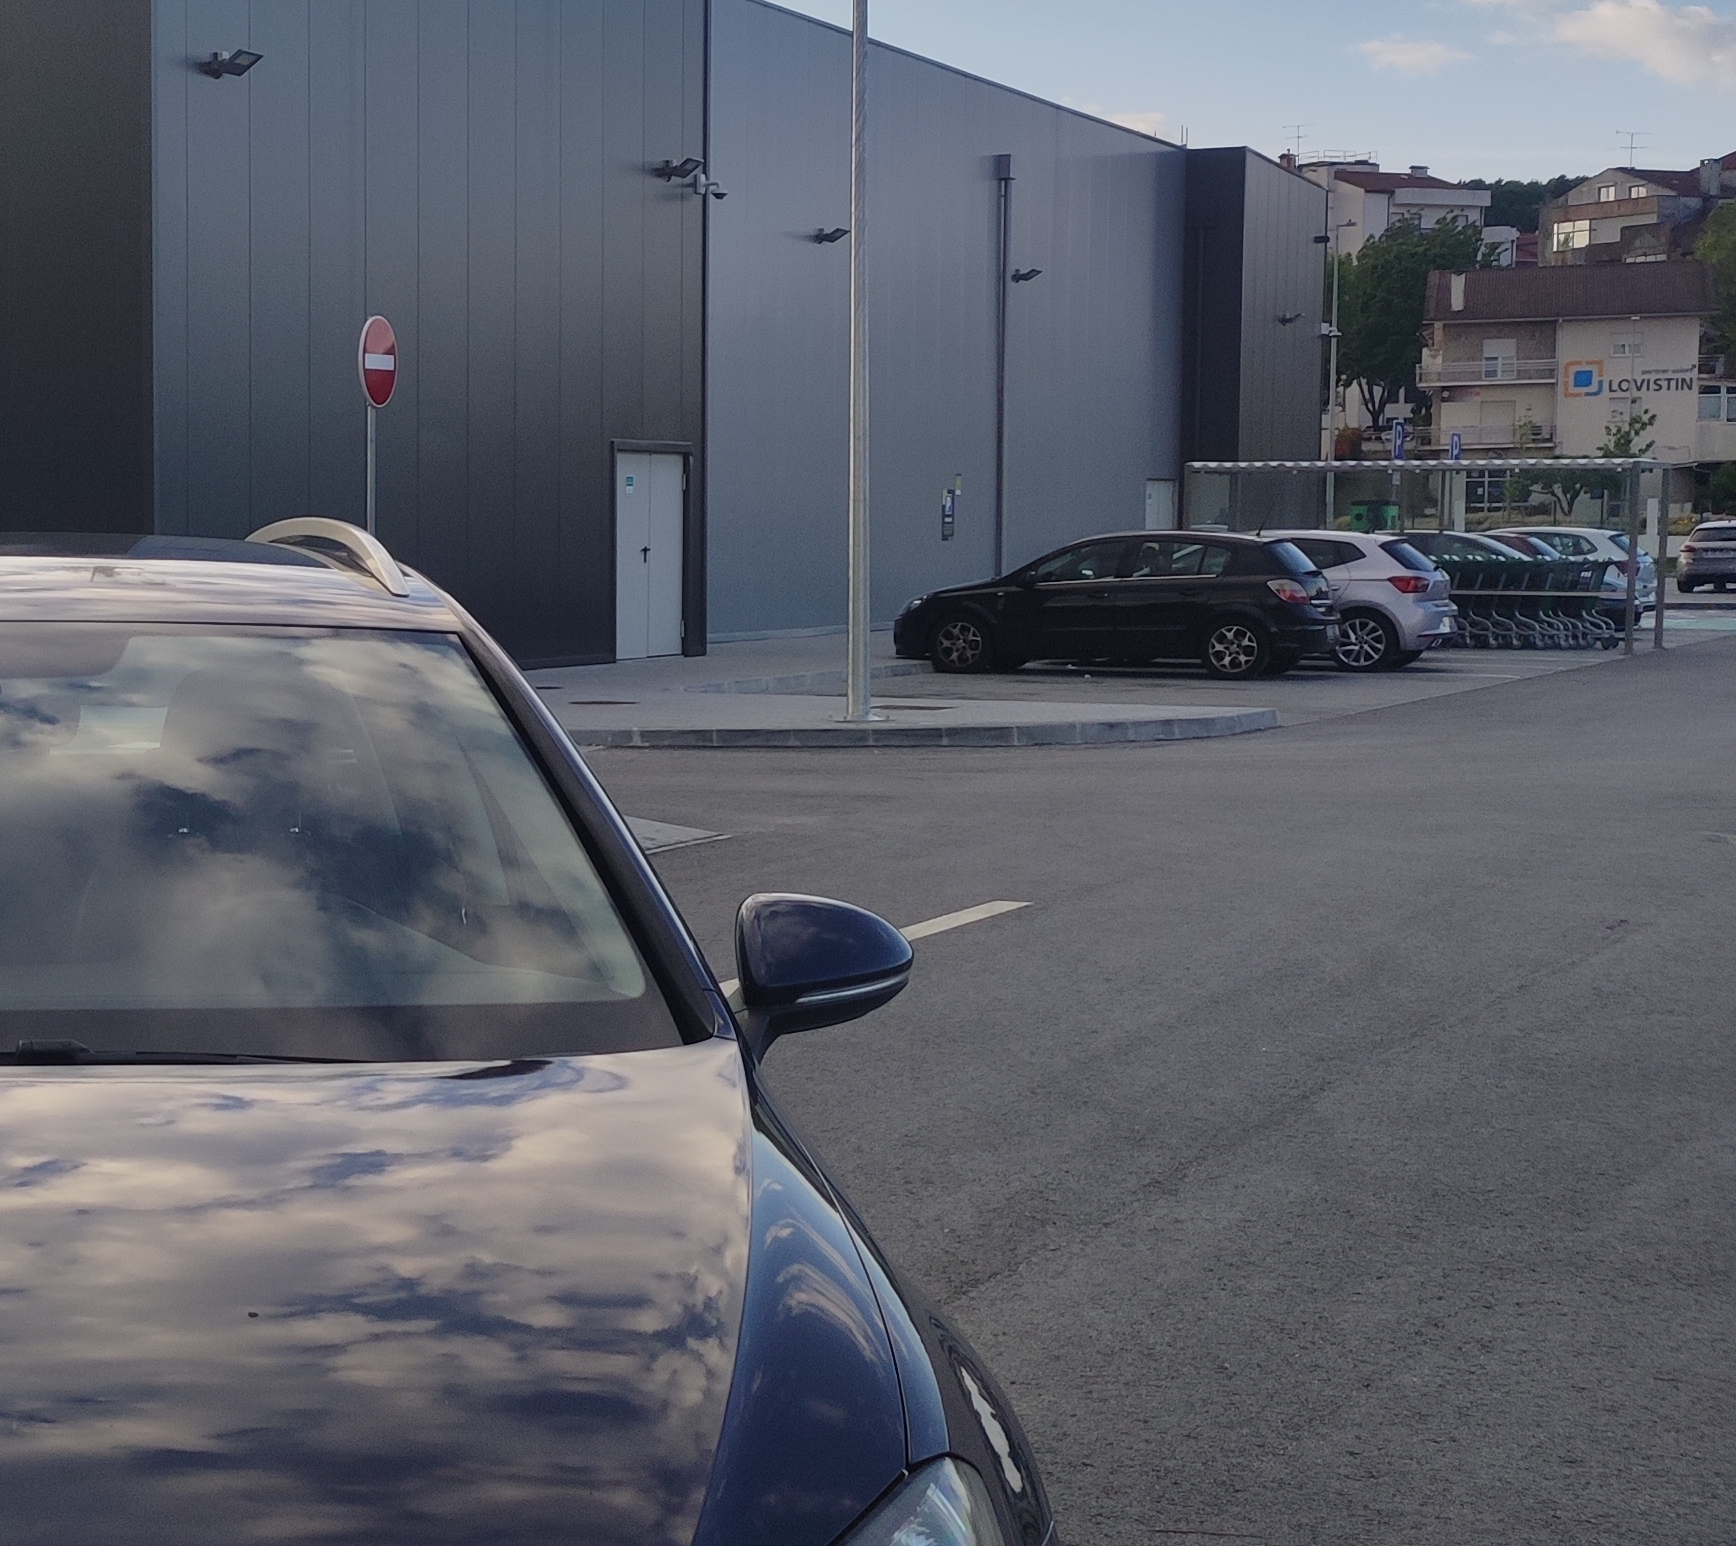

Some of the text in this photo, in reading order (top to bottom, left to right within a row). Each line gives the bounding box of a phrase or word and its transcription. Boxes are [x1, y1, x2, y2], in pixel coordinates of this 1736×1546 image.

[1608, 376, 1694, 393] LOVISTIN
[1396, 425, 1403, 456] P
[1452, 435, 1460, 460] P
